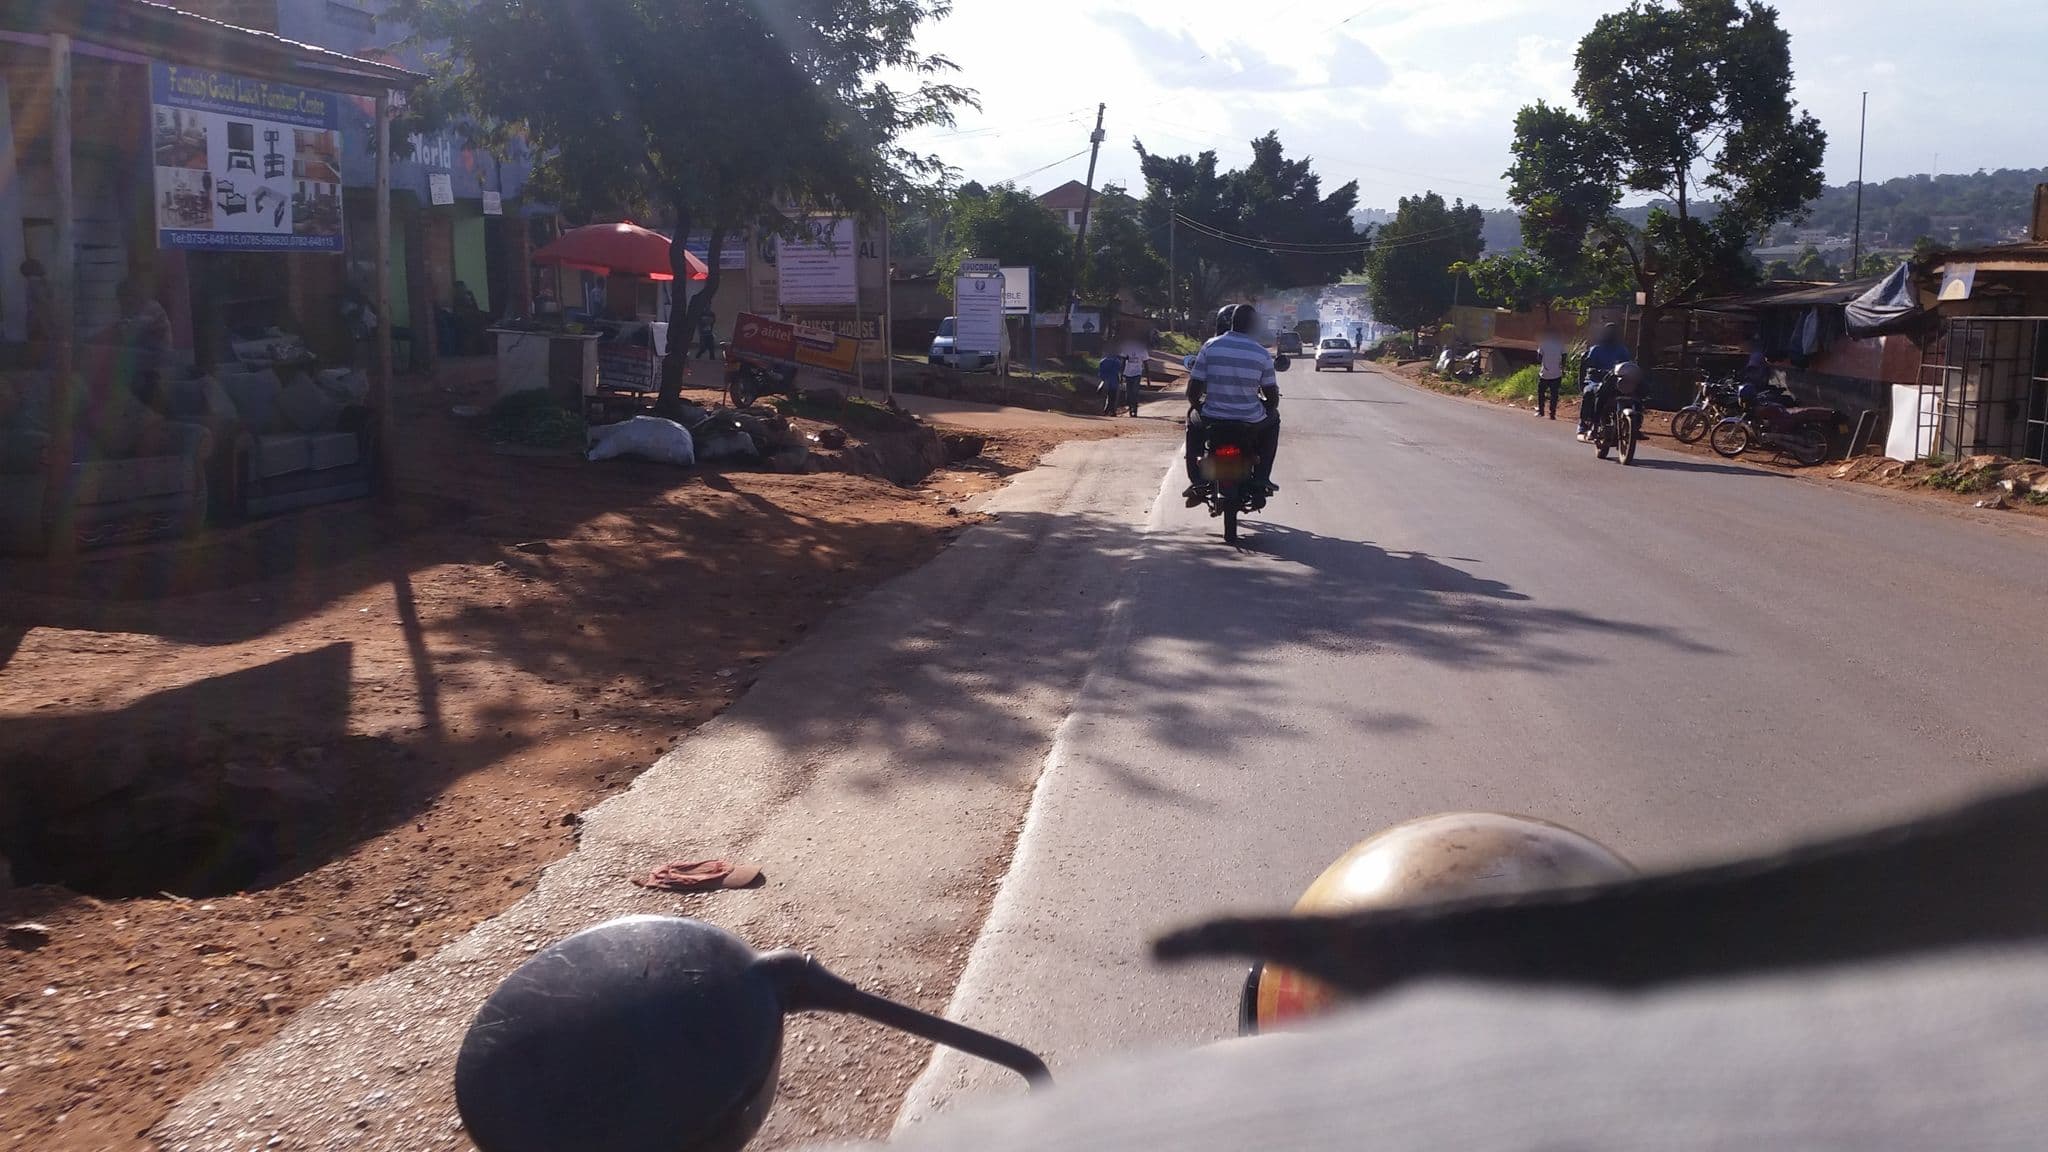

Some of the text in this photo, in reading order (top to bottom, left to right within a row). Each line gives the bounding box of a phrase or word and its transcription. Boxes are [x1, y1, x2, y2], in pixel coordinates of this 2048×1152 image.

[208, 72, 236, 101] Good
[408, 132, 451, 168] World
[761, 326, 791, 342] airtel
[837, 320, 873, 337] HOUSE
